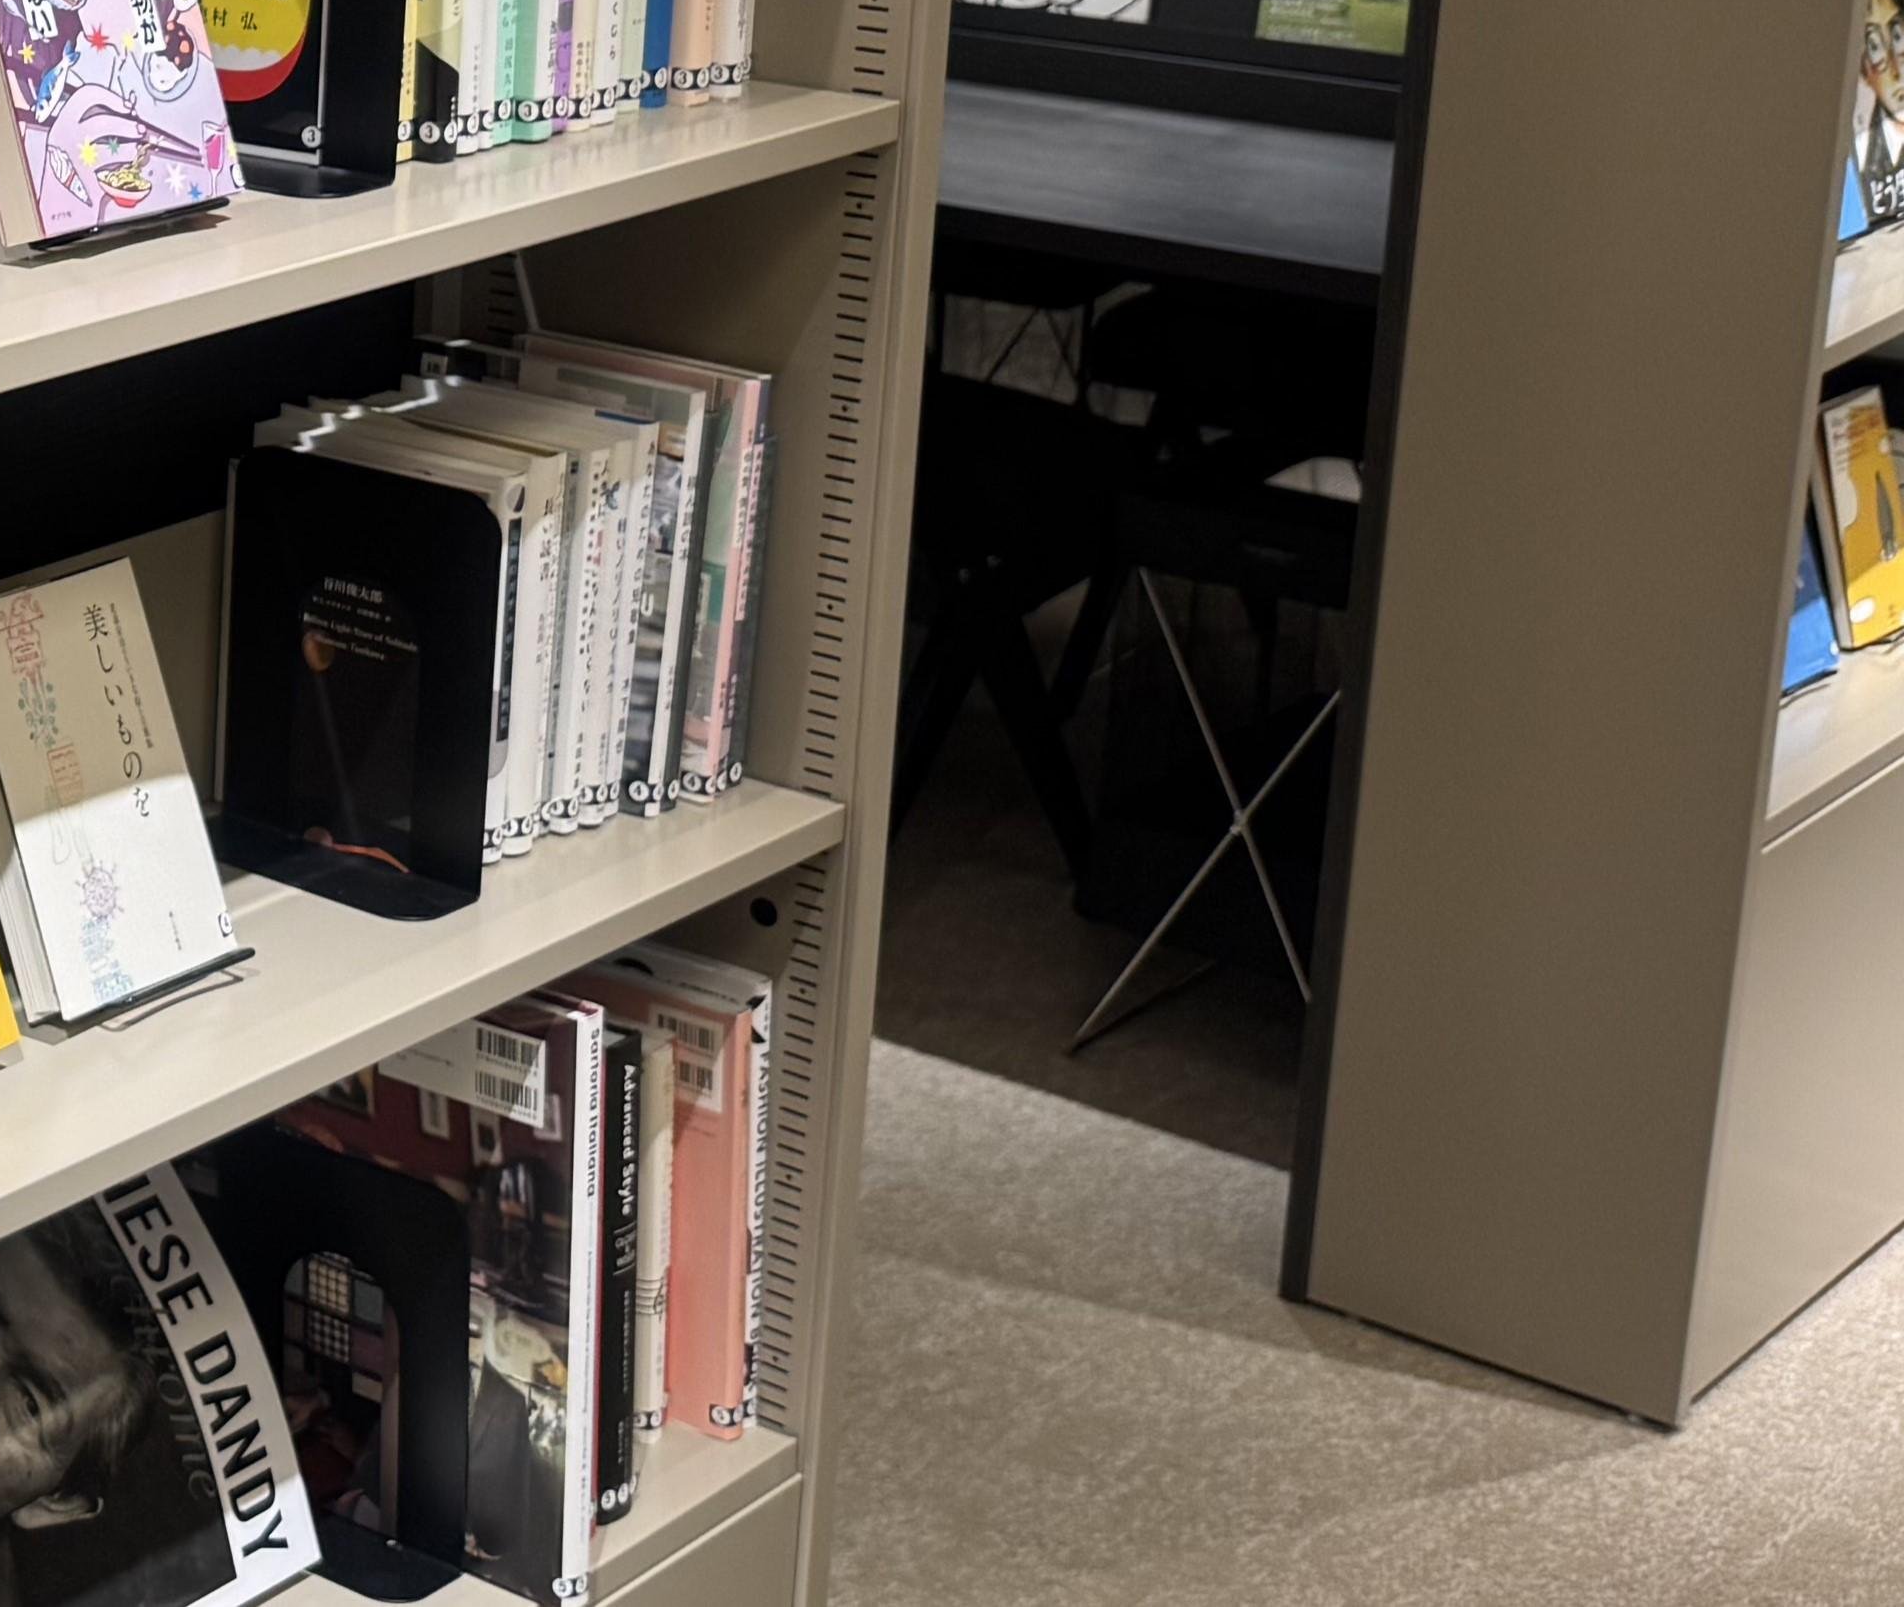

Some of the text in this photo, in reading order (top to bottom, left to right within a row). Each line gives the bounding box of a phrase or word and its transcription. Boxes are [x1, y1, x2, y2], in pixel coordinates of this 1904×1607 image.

[82, 604, 150, 818] 美しいものを
[616, 1063, 637, 1217] Advanced Style
[102, 1174, 214, 1327] ESE
[184, 1330, 289, 1558] DANDY
